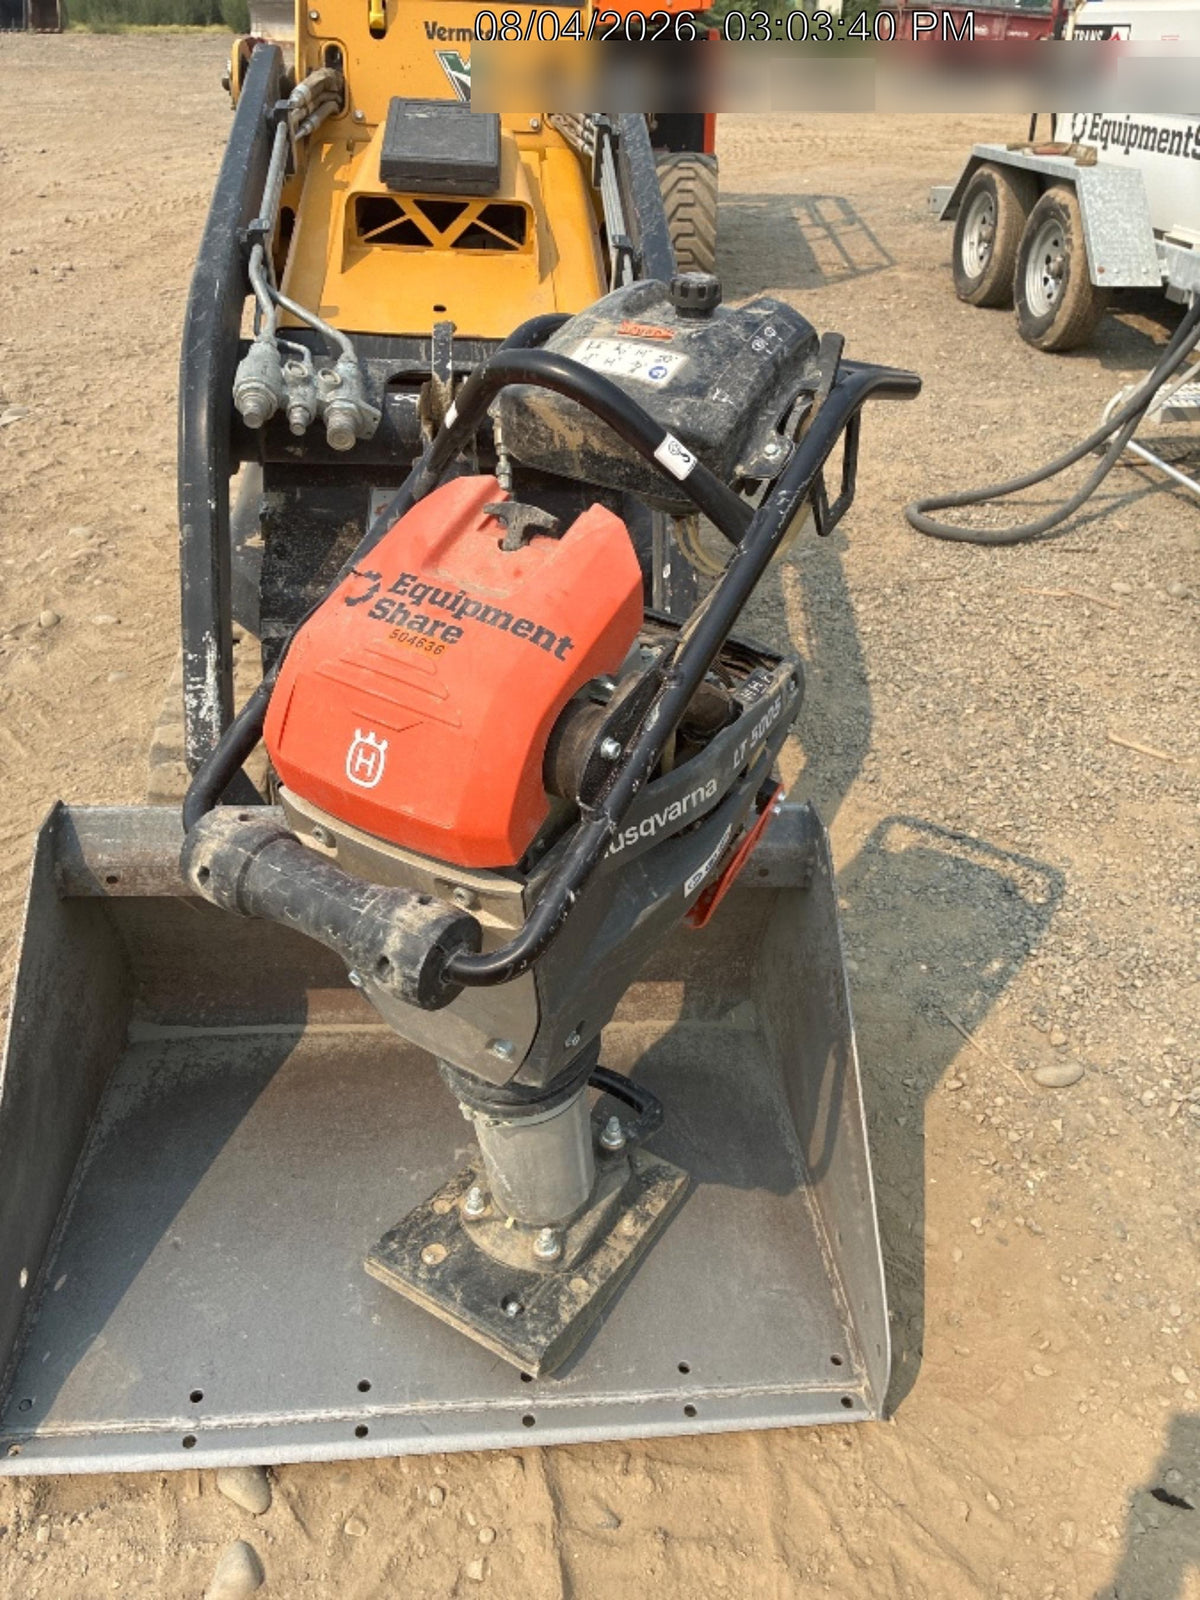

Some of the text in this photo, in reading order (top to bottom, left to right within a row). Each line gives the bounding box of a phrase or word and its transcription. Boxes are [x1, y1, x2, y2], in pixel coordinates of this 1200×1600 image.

[367, 597, 465, 645] Share
[387, 572, 575, 662] Equipment
[389, 628, 446, 655] 504636
[604, 778, 718, 859] usqvarna
